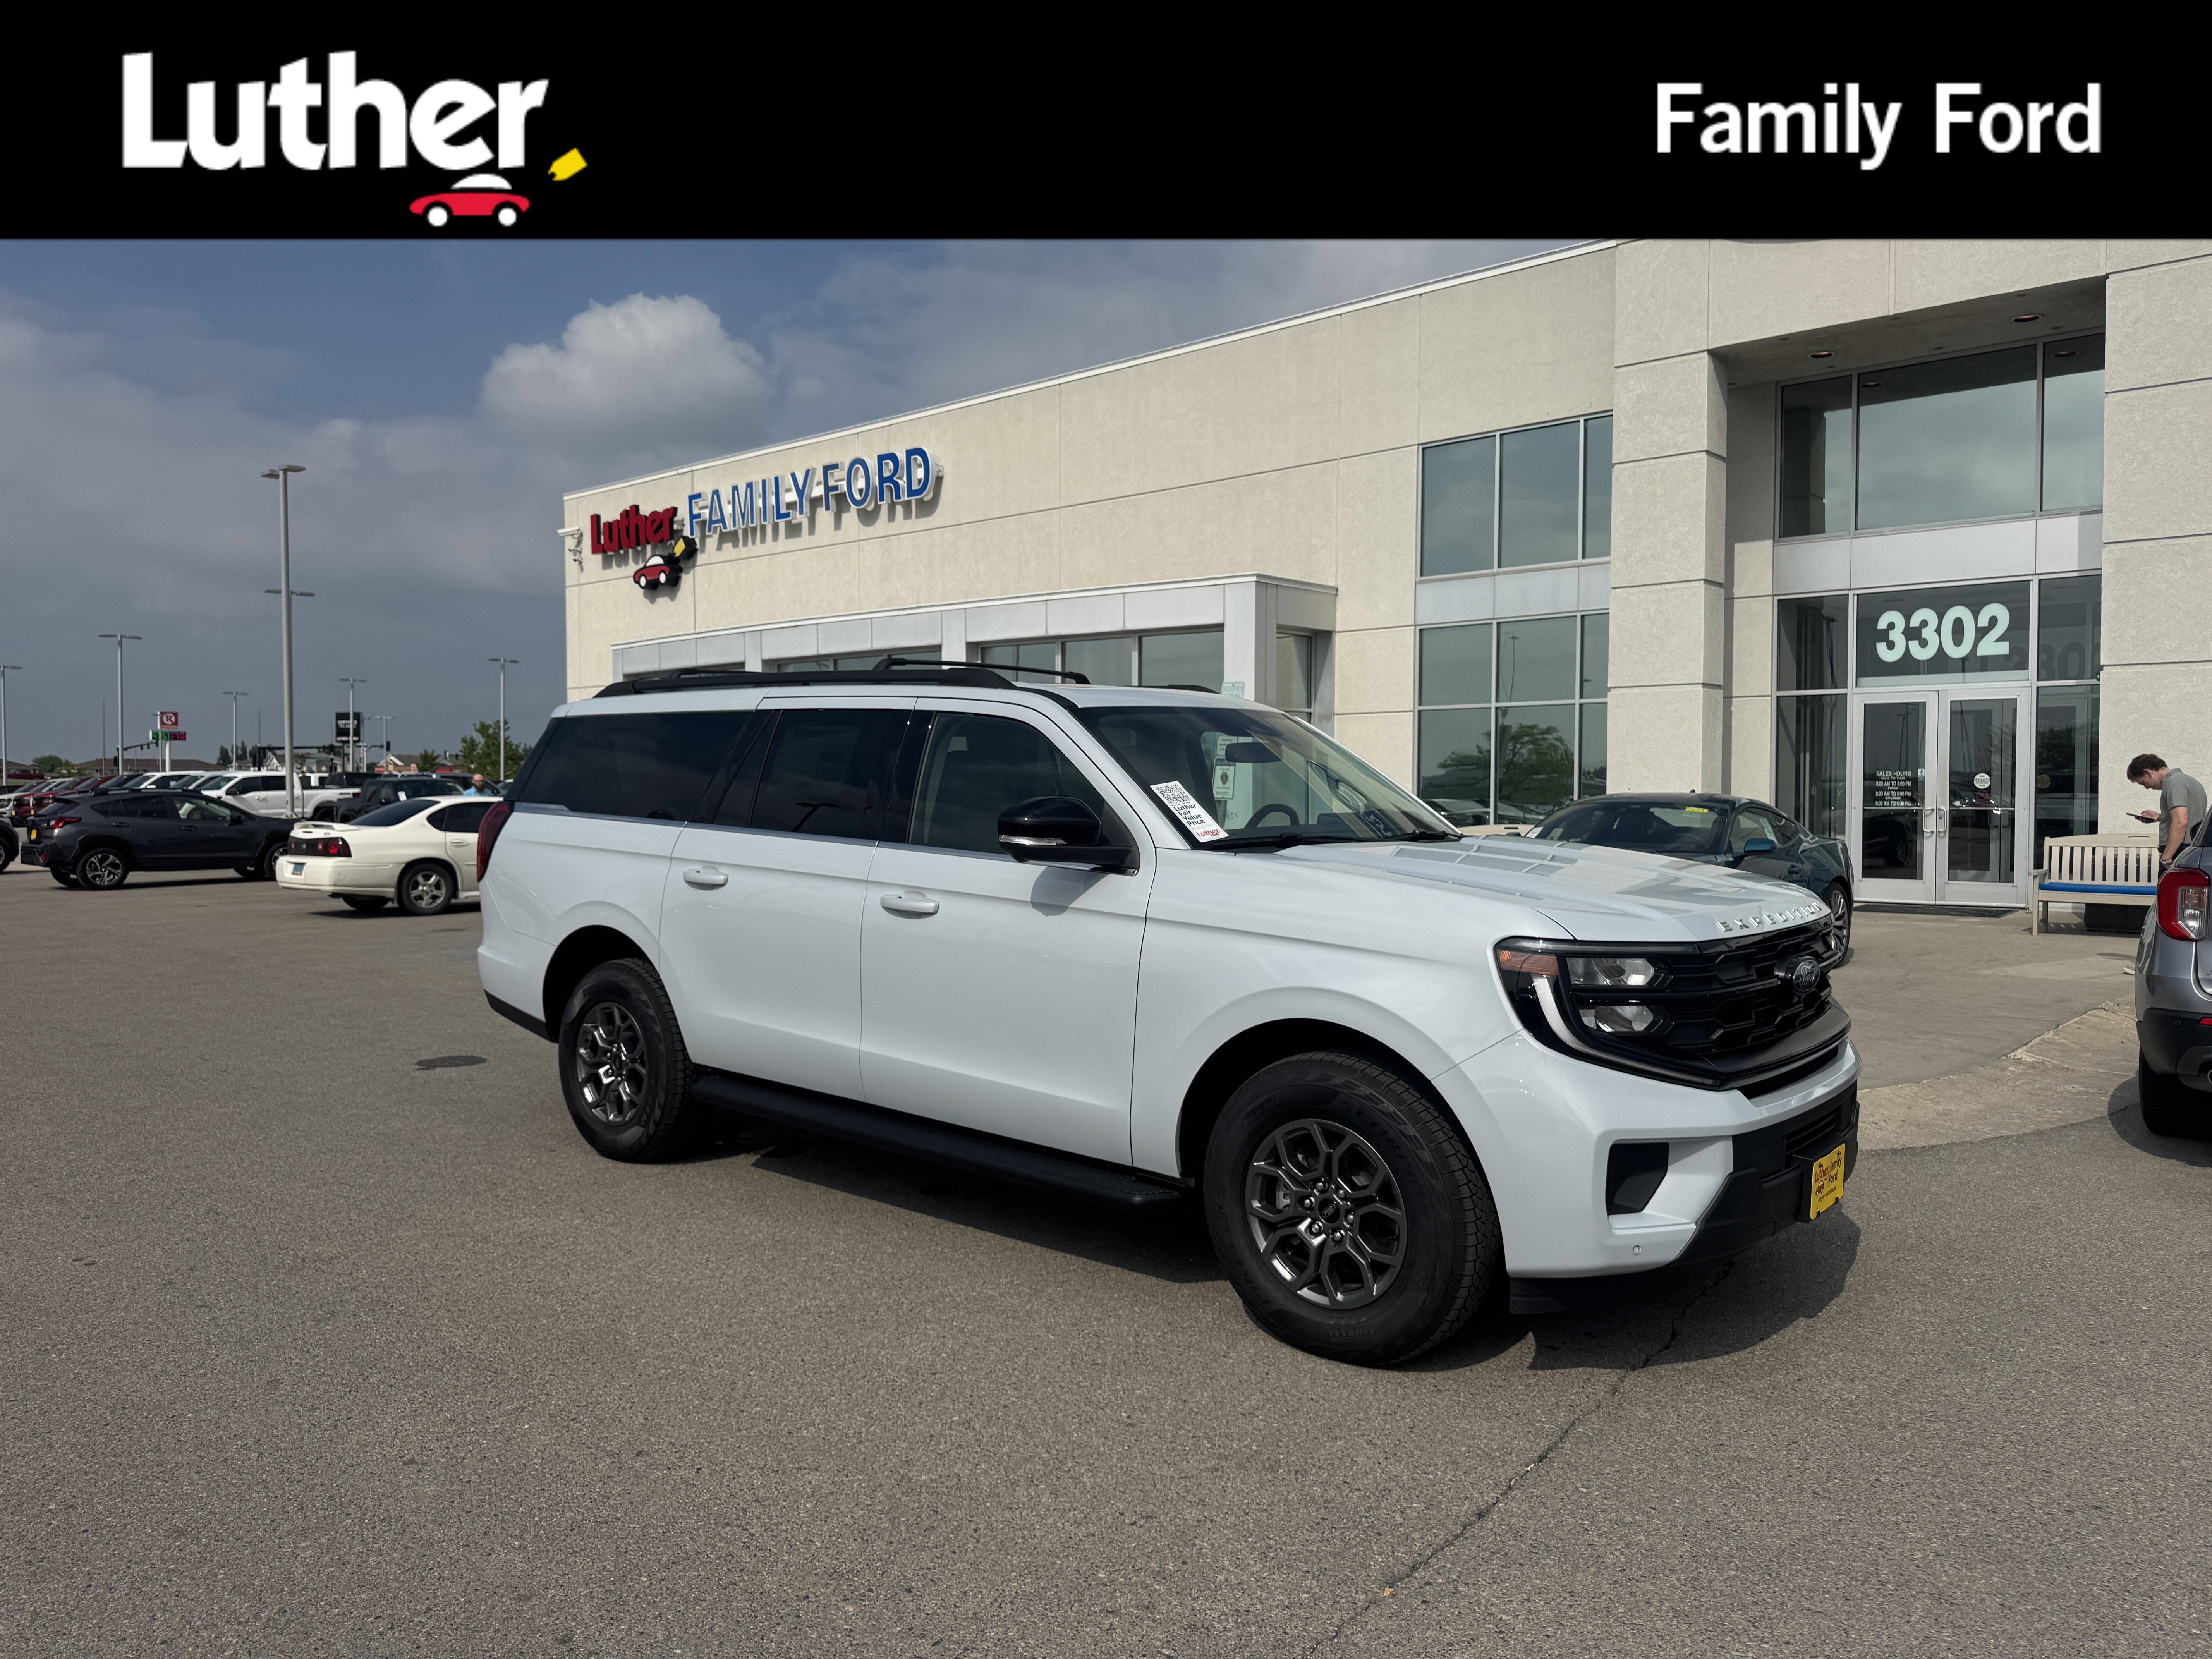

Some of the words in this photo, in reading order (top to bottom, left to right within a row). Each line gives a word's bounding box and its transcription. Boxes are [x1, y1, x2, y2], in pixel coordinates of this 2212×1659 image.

[687, 468, 812, 538] FAMILY
[822, 447, 931, 512] FORD
[591, 505, 677, 555] Luther
[1876, 603, 2010, 662] 3302
[1716, 902, 1822, 932] EXPEDITION
[1798, 964, 1817, 989] Ford
[1815, 1166, 1829, 1183] Luther
[1830, 1156, 1842, 1173] Family
[1828, 1169, 1838, 1185] Ford
